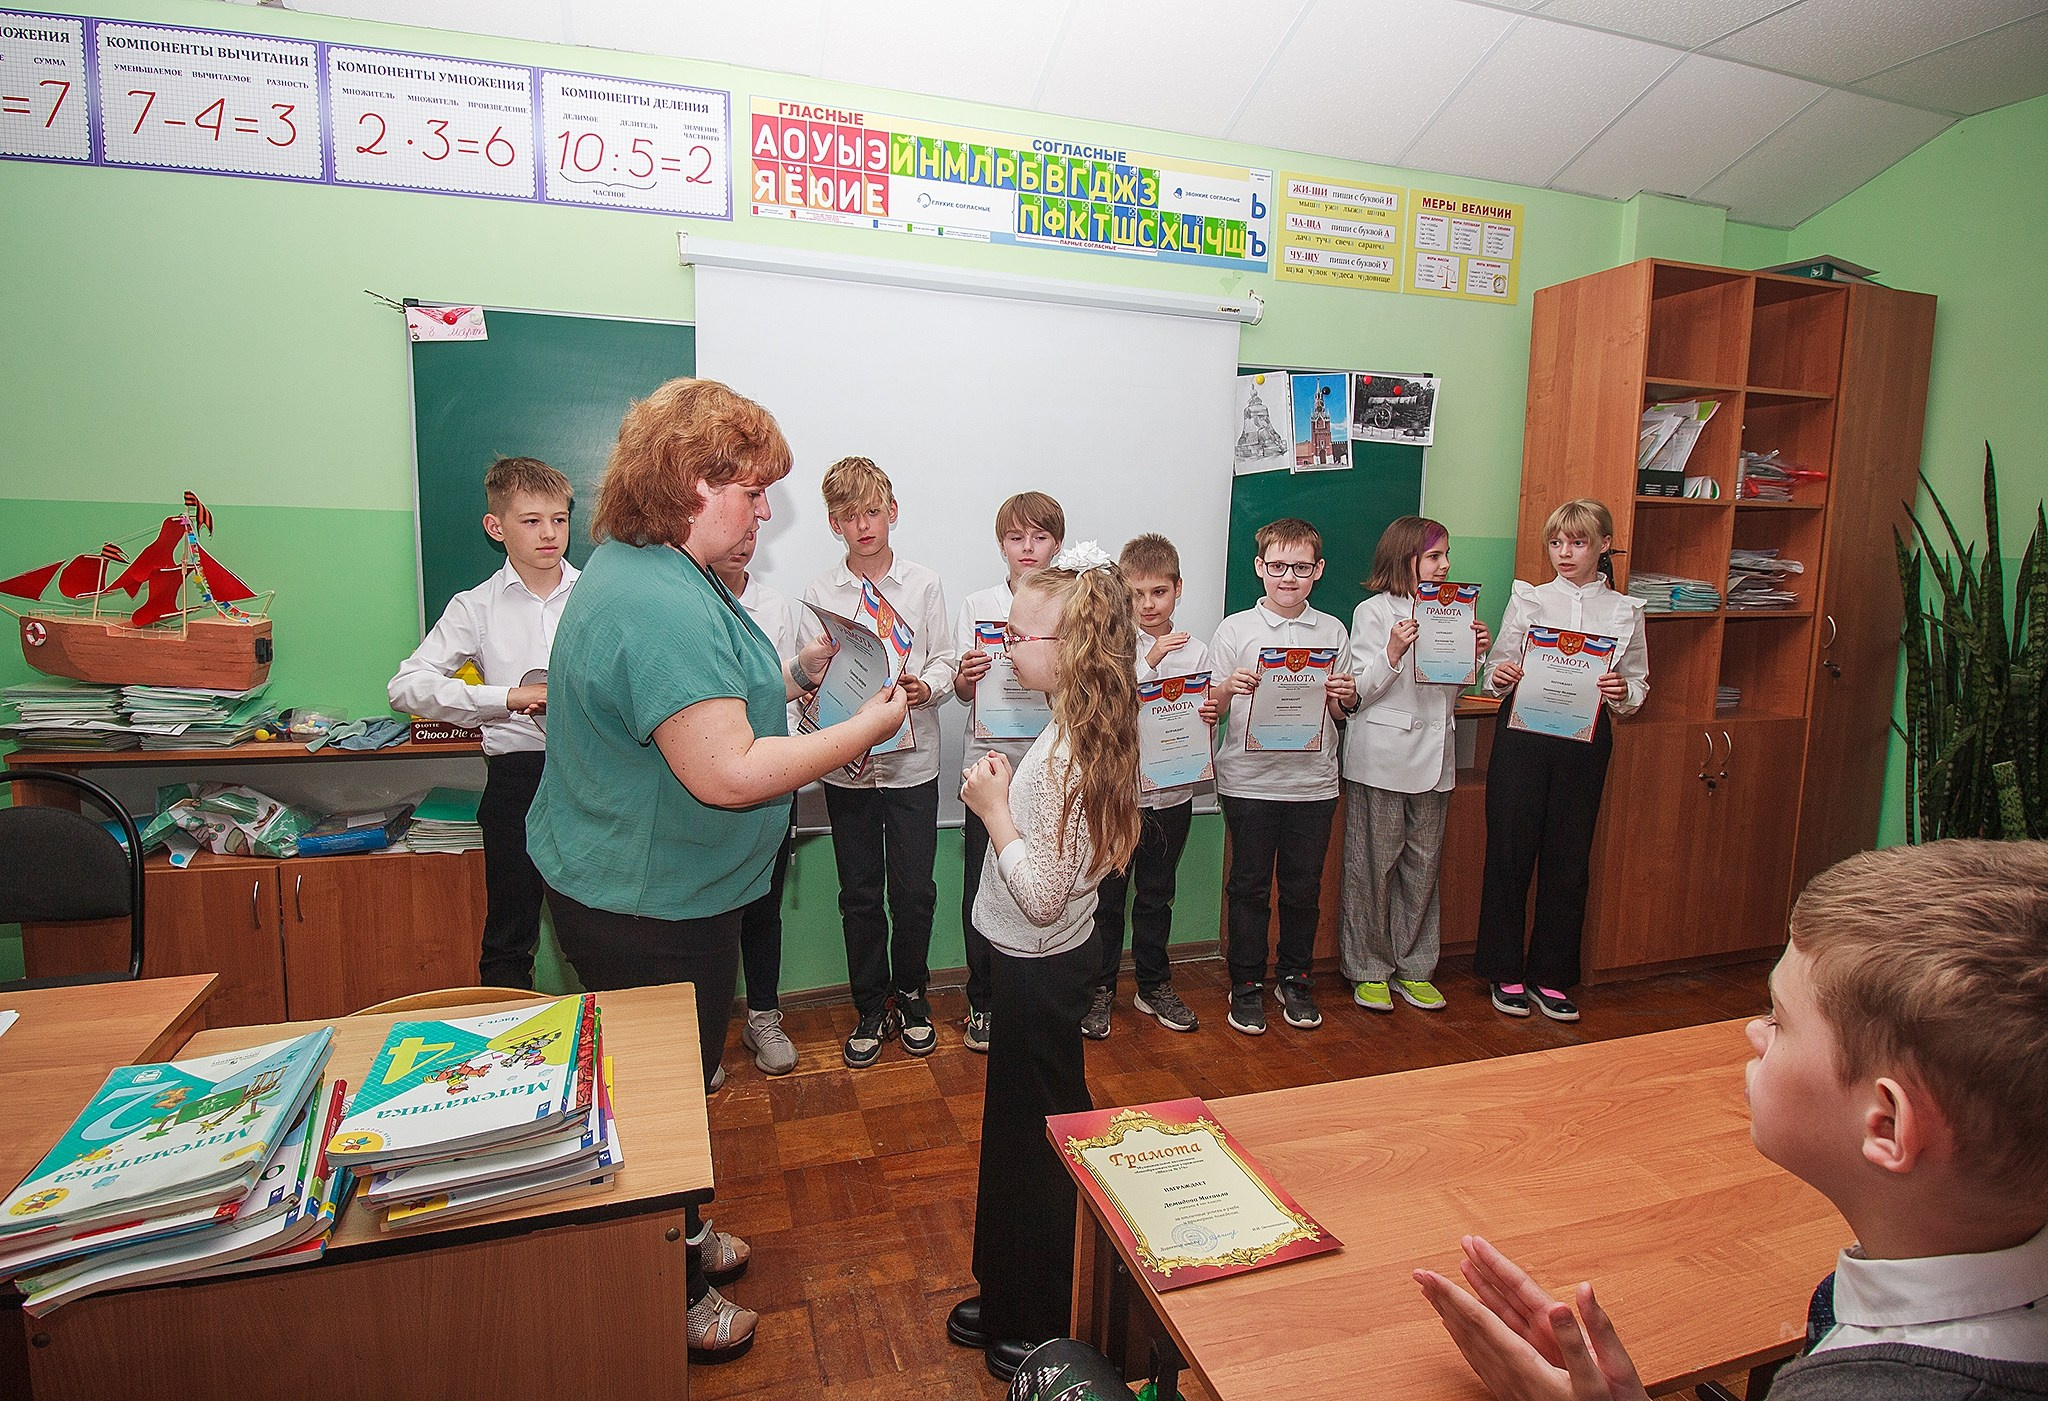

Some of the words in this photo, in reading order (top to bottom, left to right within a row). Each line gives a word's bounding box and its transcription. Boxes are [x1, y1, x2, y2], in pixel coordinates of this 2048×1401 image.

[33, 56, 66, 67] СУММА
[106, 35, 214, 57] КОМПОНЕНТЫ
[217, 47, 309, 68] ВЫЧИТАНИЯ
[114, 63, 183, 77] УМЕНЬШАЕМОЕ
[192, 70, 252, 84] ВЫЧИТАЕМОЕ
[266, 78, 309, 89] РАЗНОСТЬ
[336, 60, 435, 81] КОМПОНЕНТЫ
[438, 72, 525, 92] УМНОЖЕНИЯ
[342, 87, 395, 100] МНОЖИТЕЛЬ
[407, 93, 459, 107] МНОЖИТЕЛЬ
[467, 101, 528, 115] ПРОИЗВЕДЕНИЕ
[561, 86, 650, 107] КОМПОНЕНТЫ
[652, 96, 709, 114] ДЕЛЕНИЯ
[562, 112, 599, 124] ДЕЛИМОЕ
[620, 118, 658, 131] ДЕЛИТЕЛЬ
[778, 102, 864, 126] ГЛАСНЫЕ
[683, 123, 719, 134] ЗНАЧЕНИЕ
[683, 132, 720, 142] ЧАСТНОГО
[1032, 139, 1127, 163] СОГЛАСНЫЕ
[592, 188, 626, 199] ЧАСТНОЕ
[1185, 191, 1208, 199] ЗВОНКИЕ
[1209, 194, 1240, 203] СОГЛАСНЫЕ
[1292, 184, 1328, 196] ЖИ-ШИ
[1332, 191, 1353, 200] пиши
[1359, 192, 1385, 204] буквой
[1385, 196, 1393, 205] И
[931, 200, 954, 208] ГЛУХИЕ
[955, 203, 991, 212] СОГЛАСНЫЕ
[1252, 192, 1267, 219] Ь
[1422, 197, 1456, 212] МЕРЫ
[1461, 202, 1512, 219] ВЕЛИЧИН
[1291, 217, 1321, 230] ЧА-ЩА
[1331, 224, 1352, 232] пиши
[1358, 225, 1383, 237] буквой
[1384, 229, 1390, 238] А
[1060, 240, 1082, 248] ПАРНЫЕ
[1084, 242, 1117, 250] СОГЛАСНЫЕ
[1247, 230, 1267, 257] Ъ
[1290, 250, 1320, 263] ЧУ-ЩУ
[1329, 256, 1350, 265] пиши
[1356, 258, 1381, 269] буквой
[1382, 261, 1388, 270] У
[1332, 271, 1354, 280] чудеса
[1358, 274, 1391, 283] чудовище
[1426, 607, 1462, 616] ГРАМОТА
[1541, 653, 1590, 669] ГРАМОТА
[1272, 674, 1316, 683] ГРАМОТА
[1151, 701, 1194, 715] ГРАМОТА
[415, 730, 449, 740] Choco
[449, 728, 468, 739] Pie
[381, 1036, 455, 1085] 4
[375, 1078, 552, 1120] Математика
[81, 1079, 183, 1142] 2
[54, 1124, 256, 1184] Математика
[1108, 1142, 1203, 1169] Грамота
